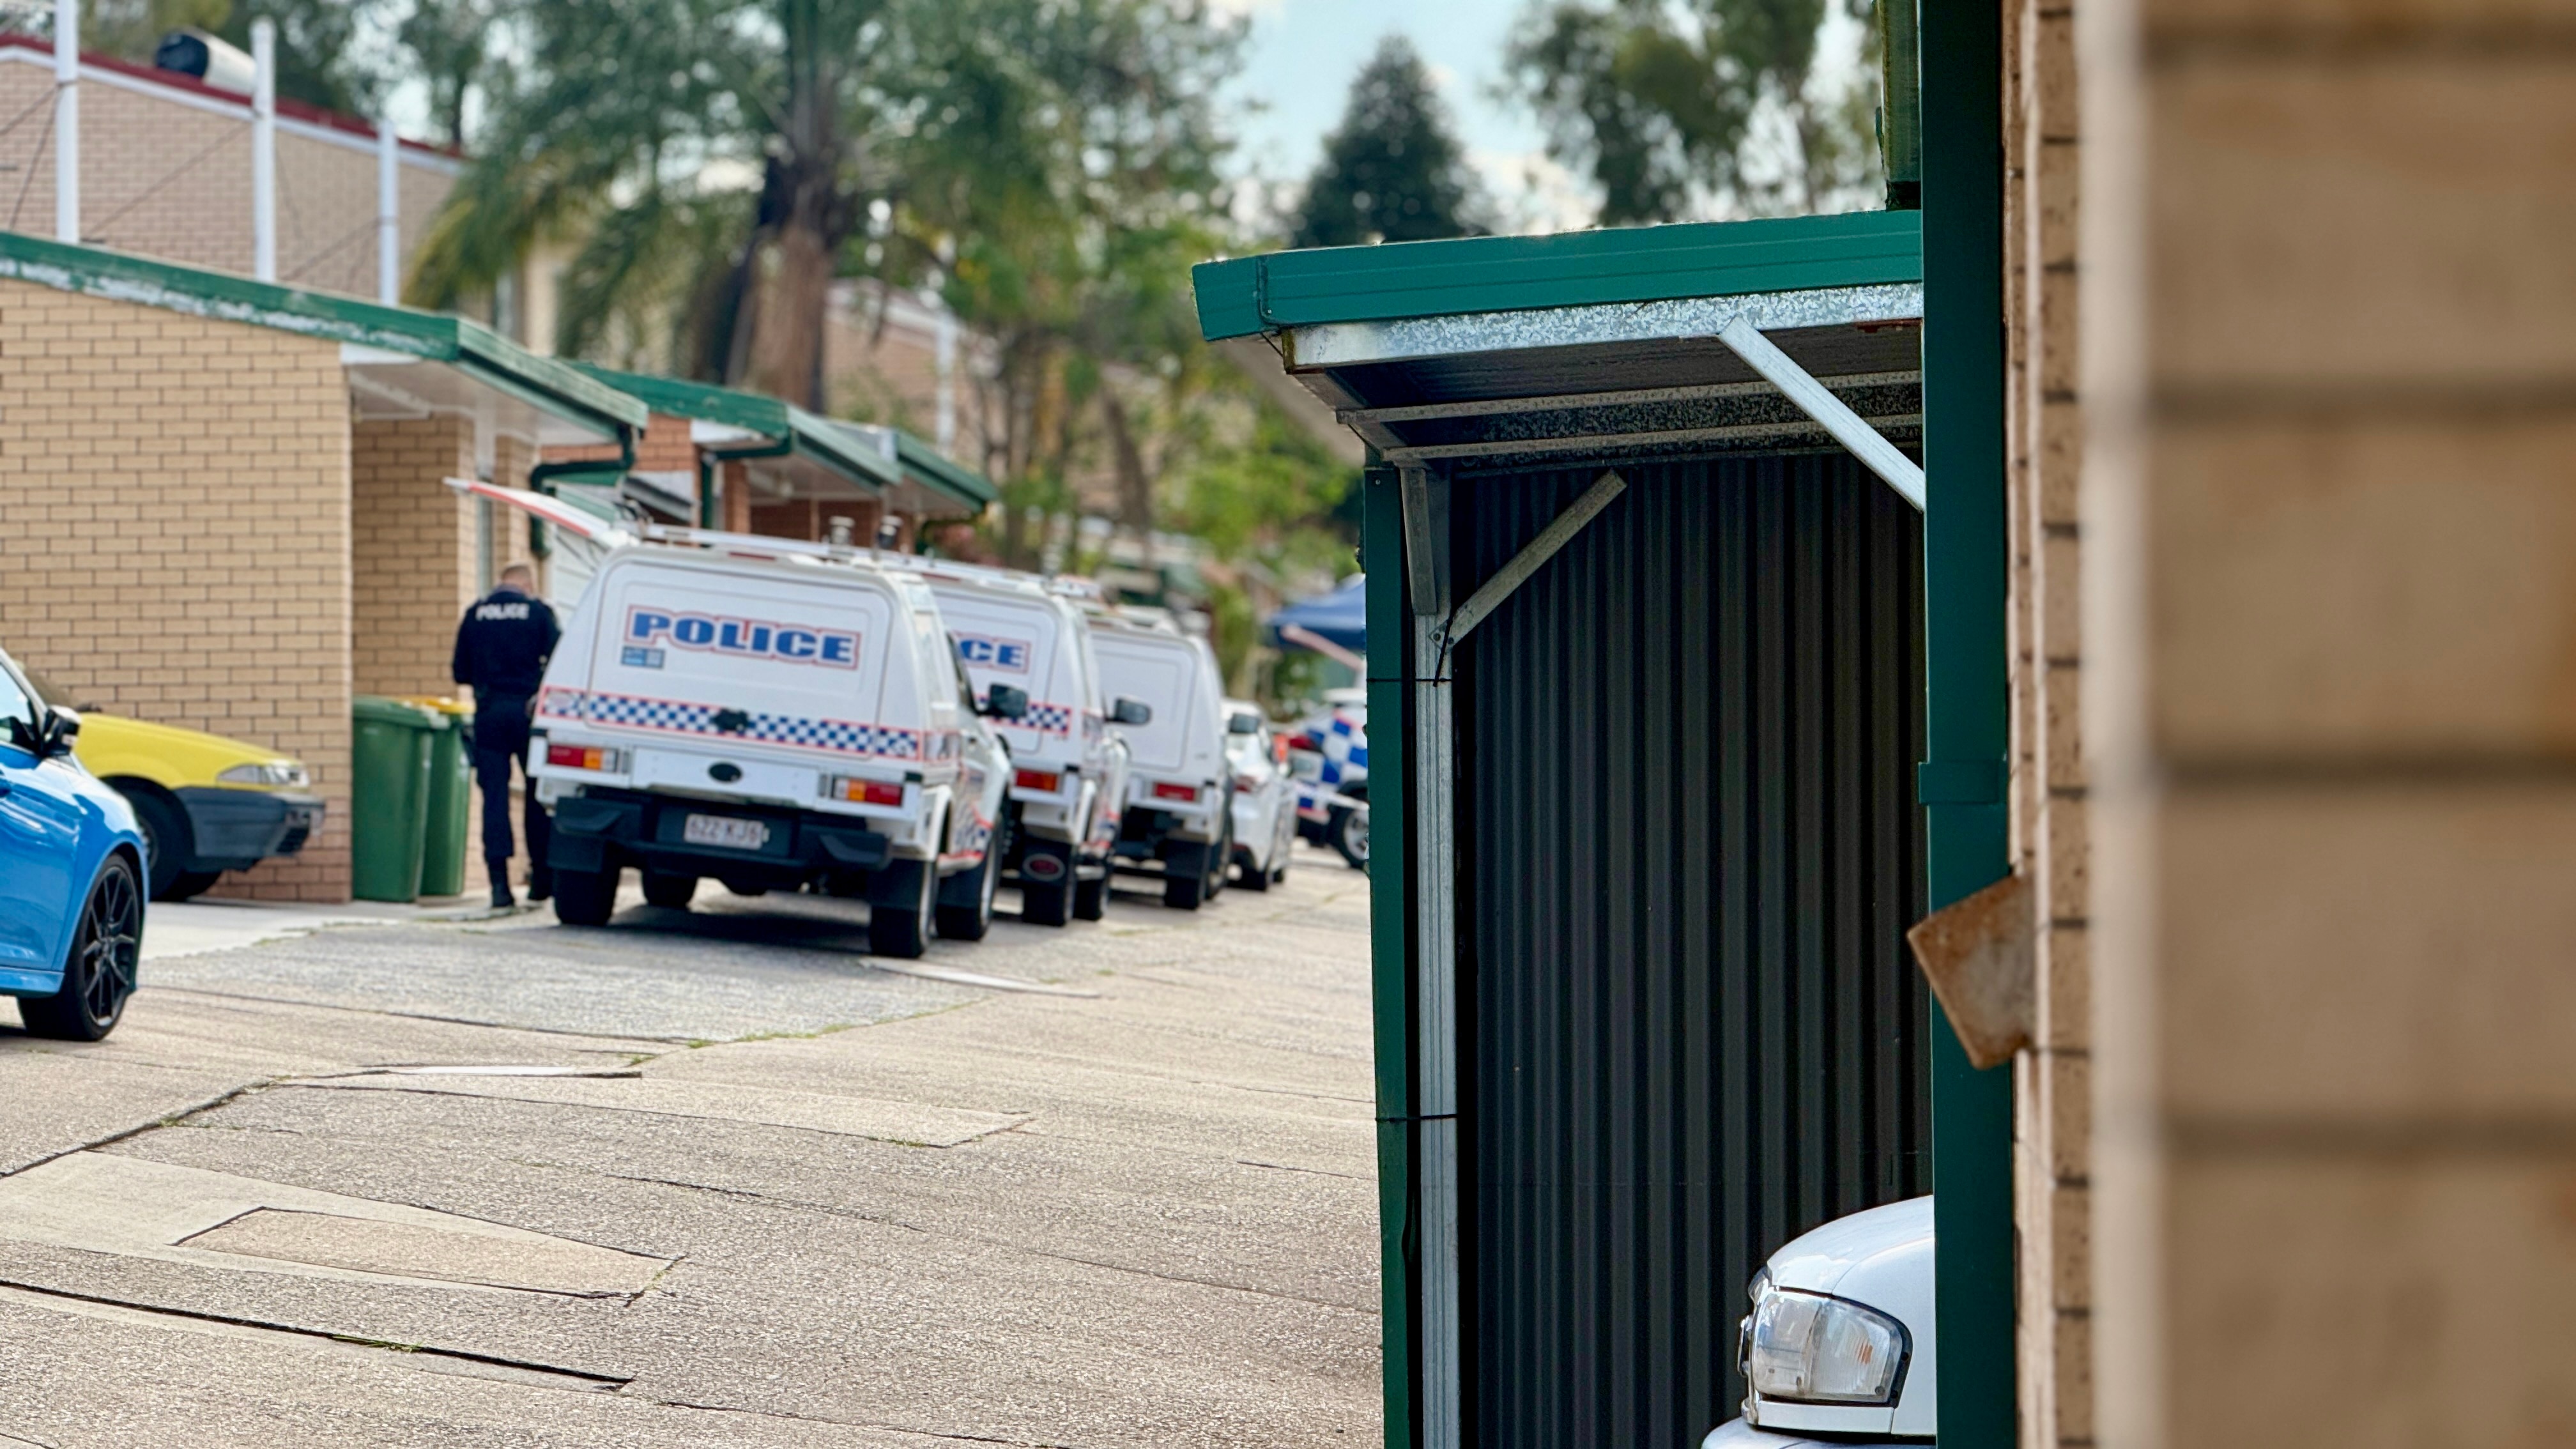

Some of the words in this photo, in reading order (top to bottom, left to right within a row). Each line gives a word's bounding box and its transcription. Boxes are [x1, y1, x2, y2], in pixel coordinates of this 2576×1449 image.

[475, 603, 530, 622] POLICE
[631, 611, 854, 664] POLICE
[960, 639, 1023, 667] CE
